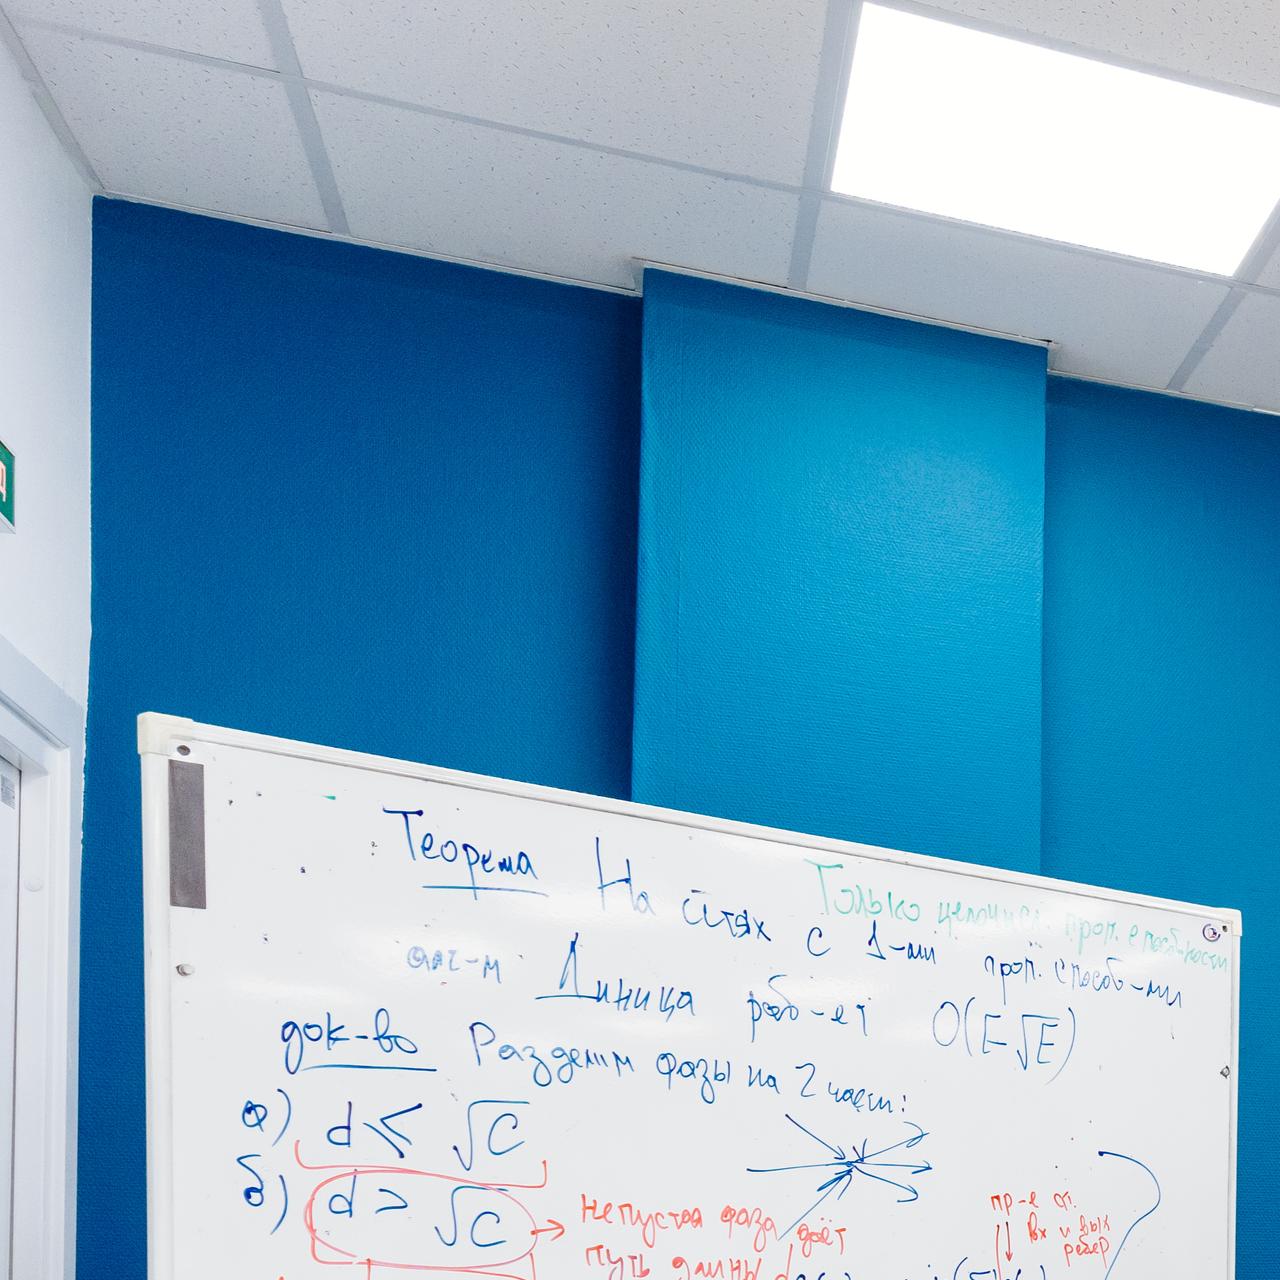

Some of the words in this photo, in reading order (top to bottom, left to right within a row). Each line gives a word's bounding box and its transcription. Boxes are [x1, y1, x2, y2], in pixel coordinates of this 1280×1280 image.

[382, 808, 539, 900] Теорема
[596, 836, 655, 914] На
[804, 858, 921, 923] Только
[535, 932, 697, 1022] Диница
[655, 1054, 732, 1104] фазы
[747, 1065, 781, 1094] на
[795, 1062, 817, 1098] 2
[326, 1100, 353, 1148] d
[328, 1168, 358, 1218] d
[720, 1204, 779, 1253] фаза
